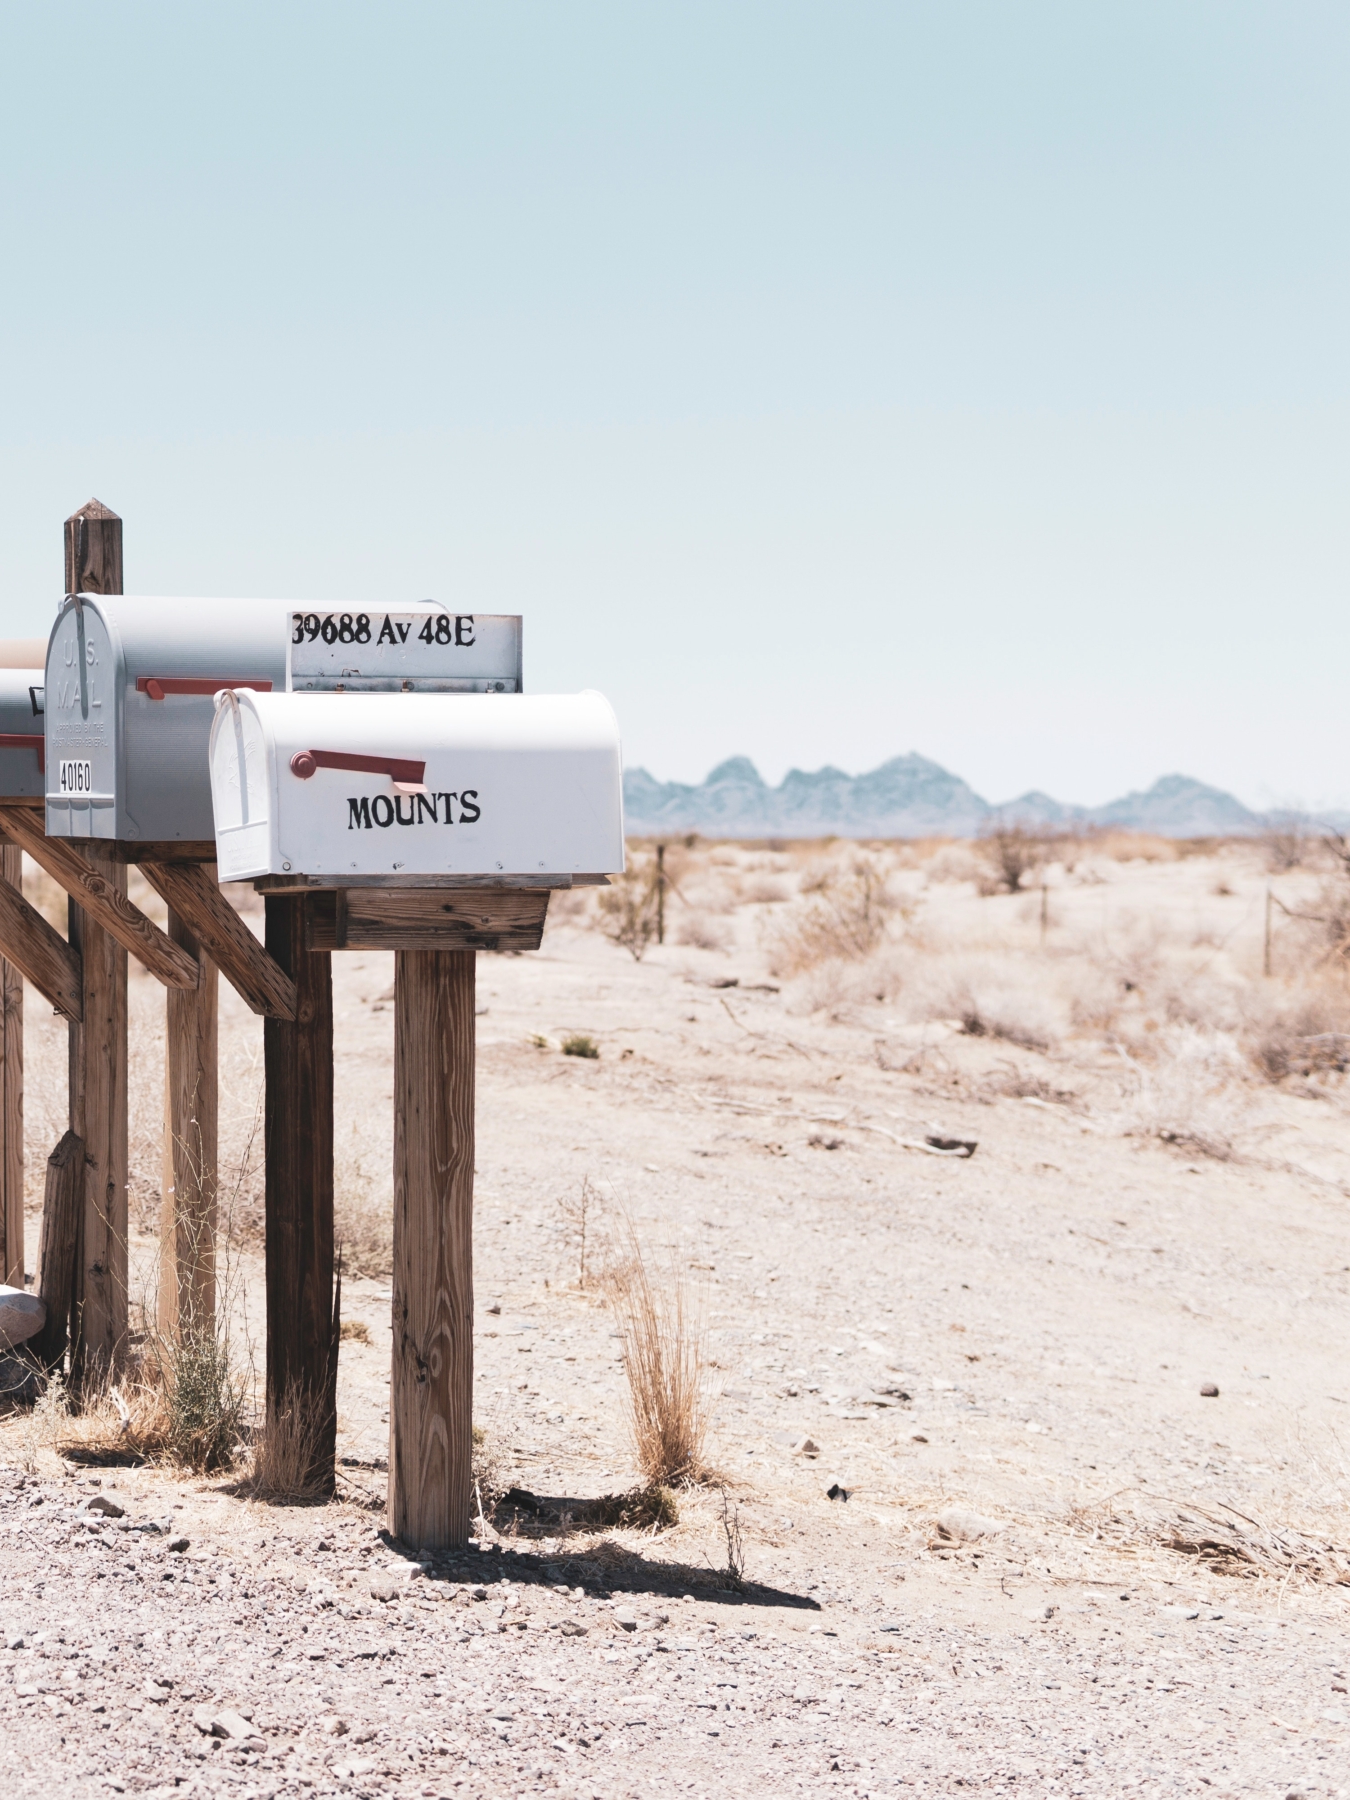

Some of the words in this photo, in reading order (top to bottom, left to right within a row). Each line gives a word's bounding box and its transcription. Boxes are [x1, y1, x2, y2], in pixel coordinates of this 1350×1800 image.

[292, 613, 372, 646] 39688
[376, 613, 412, 647] Av
[58, 680, 102, 709] MAL
[93, 721, 105, 734] THE
[61, 762, 91, 792] 40160
[347, 790, 481, 830] MOUNTS
